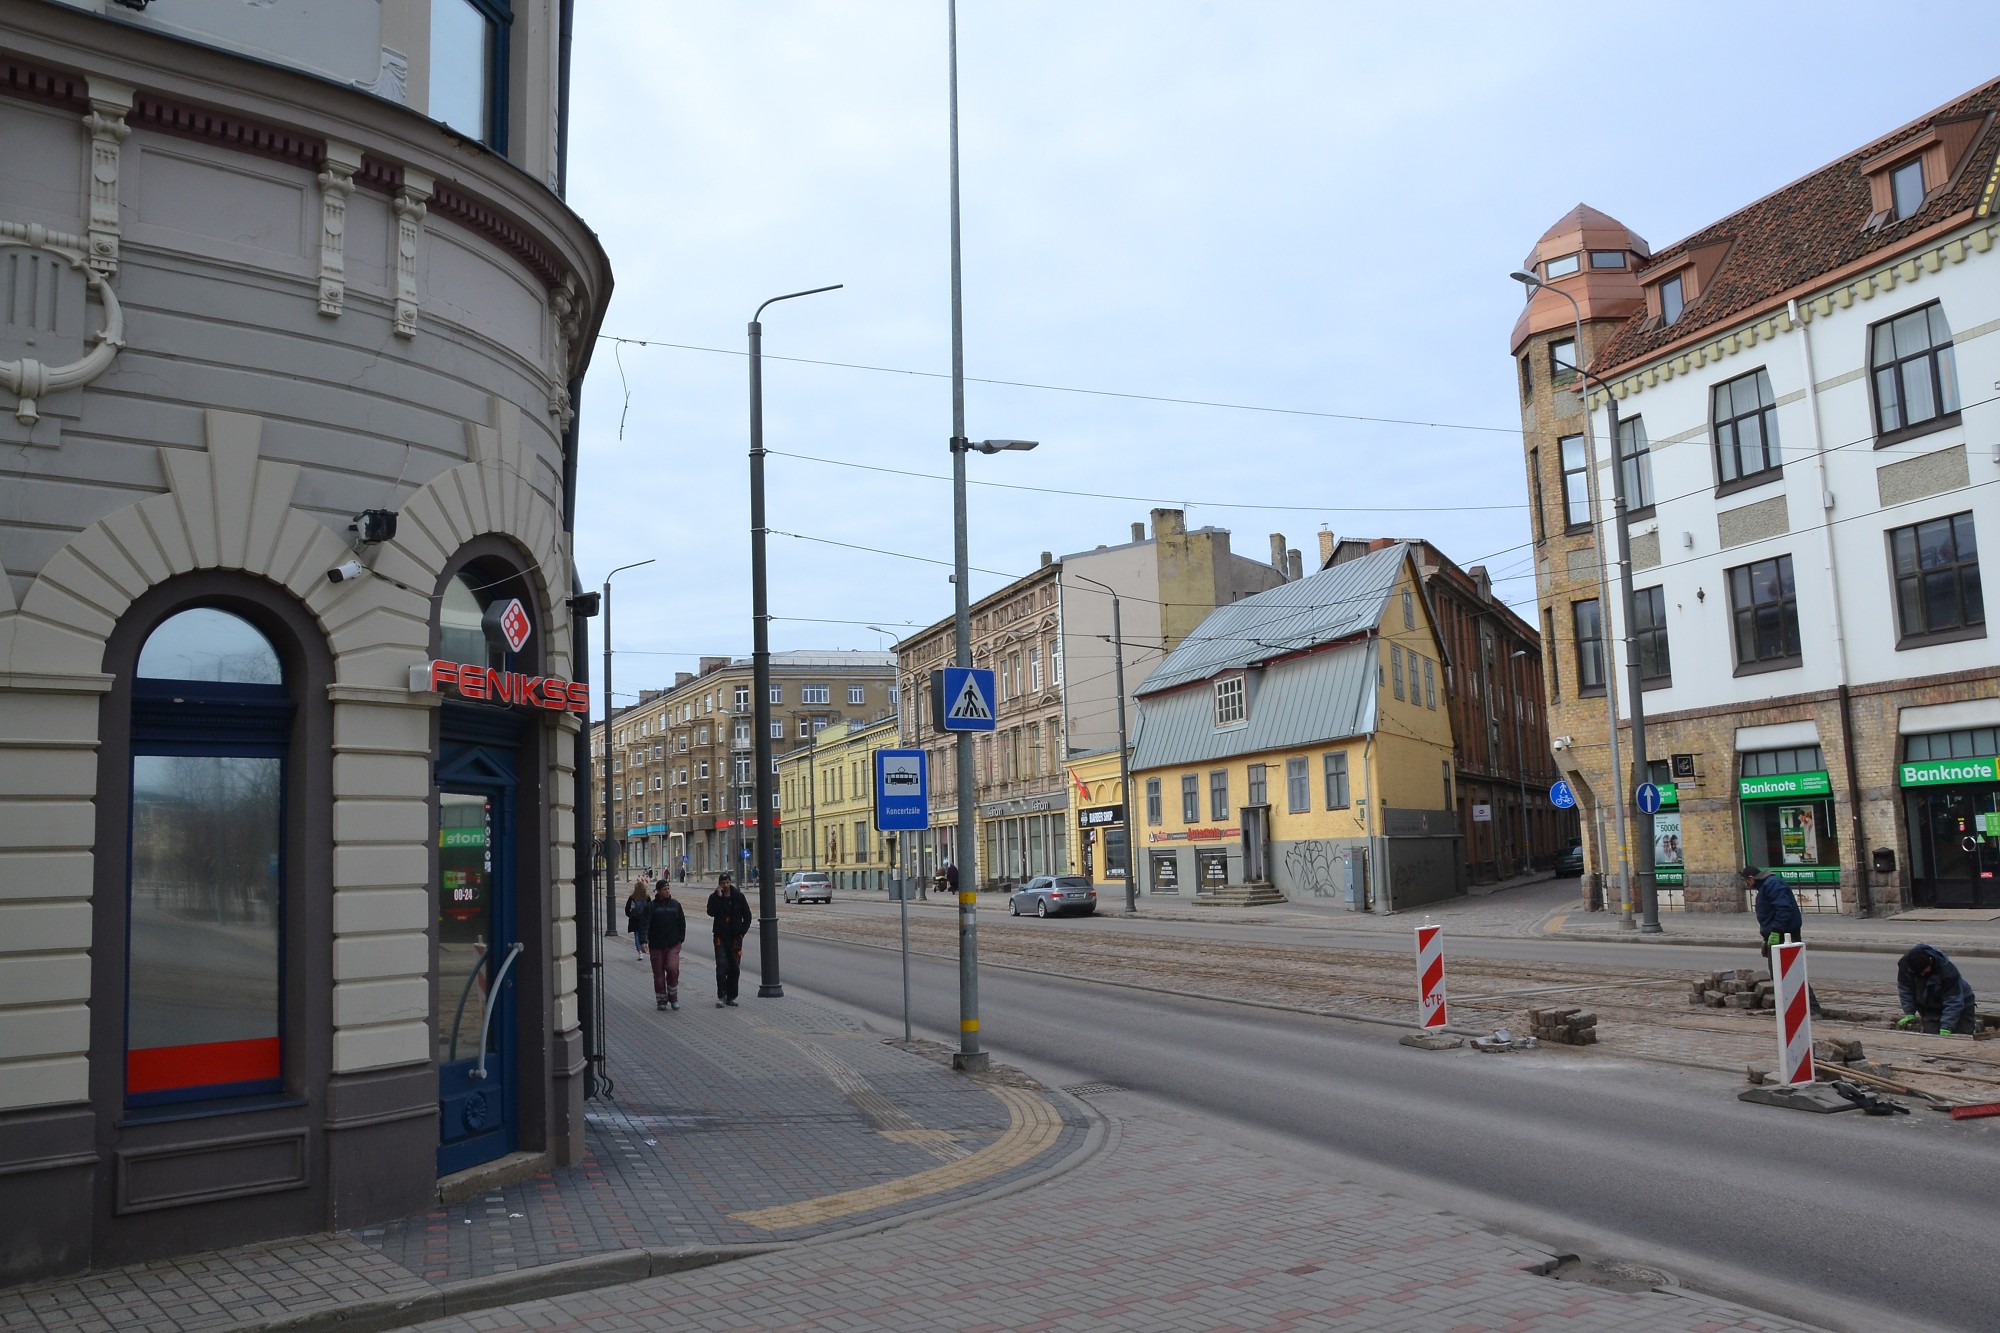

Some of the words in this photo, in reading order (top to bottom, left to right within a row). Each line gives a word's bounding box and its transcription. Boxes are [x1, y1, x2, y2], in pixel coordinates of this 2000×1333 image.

[431, 659, 589, 712] FENIKSS
[1903, 764, 1992, 782] Banknote
[1741, 781, 1796, 794] Banknote
[886, 806, 920, 815] Koncertzāle
[453, 888, 473, 901] 00-24
